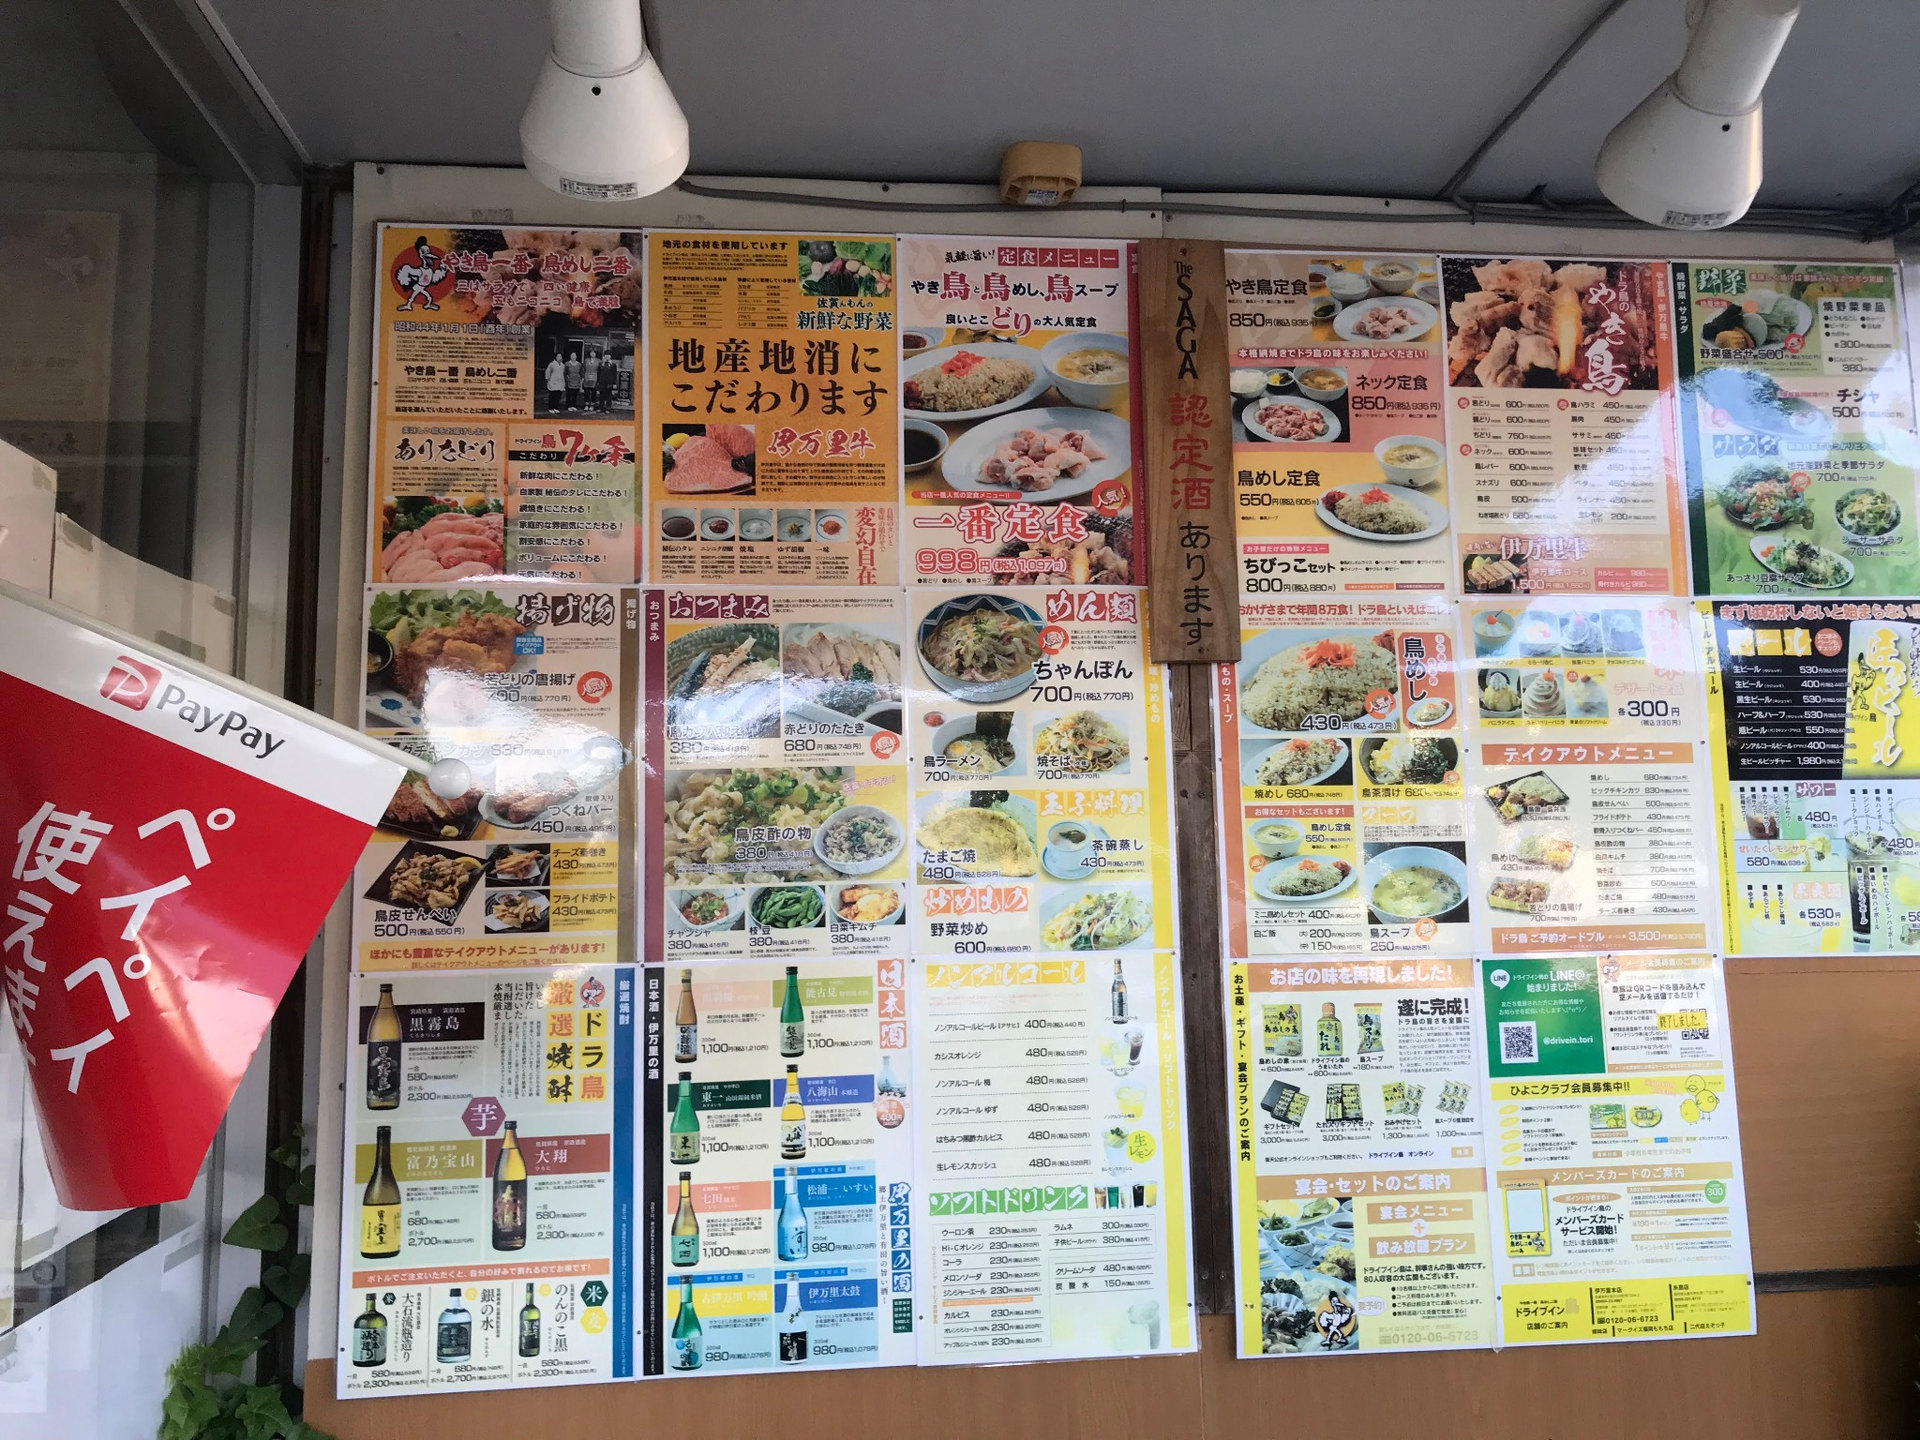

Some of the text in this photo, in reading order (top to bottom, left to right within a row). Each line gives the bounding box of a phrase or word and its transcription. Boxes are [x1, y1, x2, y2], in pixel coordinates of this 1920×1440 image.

[662, 240, 788, 250] 地元の食材を使用しています
[440, 250, 632, 276] やき鳥一番 鳥めし二番
[1000, 248, 1117, 266] 定食メニュー
[1175, 261, 1193, 275] The
[1226, 279, 1308, 296] やき鳥定食
[797, 311, 893, 331] 新鮮な野菜
[1175, 275, 1199, 380] SAGA
[668, 338, 882, 375] 地産地消に
[404, 366, 517, 379] やき鳥一番 鳥めし二番
[1356, 375, 1428, 390] ネック定食
[671, 379, 888, 416] こだわります
[767, 427, 876, 459] 伊万里牛
[1168, 392, 1215, 510] 認定酒
[1238, 470, 1321, 487] 鳥めし定食
[913, 502, 1090, 544] 一番定食
[855, 507, 877, 586] 変幻自在
[1244, 558, 1335, 574] ちびっこセット
[1180, 521, 1214, 647] あります
[515, 592, 616, 627] 揚げ物
[669, 592, 770, 620] おつまみ
[1047, 589, 1138, 623] めん類
[649, 601, 660, 641] おつまみ
[1033, 659, 1133, 681] ちゃんぽん
[1403, 637, 1428, 702] 鳥めし
[156, 682, 287, 761] PayPay
[784, 723, 865, 735] 赤どりのたたき
[924, 756, 981, 767] 鳥ラーメン
[1037, 755, 1071, 767] 焼そば
[1504, 748, 1673, 763] テイクアウトメニュー
[1254, 789, 1284, 799] 焼めし
[548, 805, 613, 817] つくねバー
[735, 827, 812, 842] 鳥皮酢の物
[1311, 823, 1351, 832] 鳥めし定食
[1092, 839, 1144, 851] 茶碗蒸し
[923, 849, 976, 864] たまご焼
[553, 893, 616, 904] フライドポテト
[375, 908, 457, 923] 鳥皮せんべい
[3, 801, 114, 1067] 使えま
[667, 928, 712, 938] チャンジャ
[749, 925, 771, 935] 枝豆
[830, 922, 877, 933] 白菜キムチ
[930, 922, 988, 937] 野菜炒め
[1254, 929, 1276, 938] 白ご飯
[1370, 928, 1410, 938] 鳥スープ
[50, 807, 237, 1095] ペイペイ
[1270, 968, 1453, 985] お店の味を再現しました!
[1397, 998, 1470, 1016] 遂に完成!
[648, 979, 659, 1080] 日本酒・伊万里の酒
[1543, 1035, 1594, 1045] @drivein.tori
[579, 1012, 607, 1101] ドラ鳥
[934, 1051, 981, 1060] カシスオレンジ
[806, 1084, 838, 1098] 八海山
[935, 1079, 981, 1088] ノンアルコール
[1510, 1082, 1630, 1096] ひよこクラブ会員募集中!!
[470, 1104, 498, 1131] 芋
[936, 1106, 983, 1115] ノンアルコール
[937, 1161, 997, 1171] 生レモンスカッシュ
[1552, 1167, 1685, 1182] メンバーズカードのご案内
[1295, 1174, 1451, 1196] 宴会・セットのご案内
[929, 1185, 1088, 1216] ソフトドリンク
[1380, 1206, 1464, 1220] 宴会メニュー
[1555, 1214, 1624, 1225] メンバーズカード
[941, 1228, 975, 1237] ウーロン茶
[1054, 1224, 1074, 1232] ラムネ
[943, 1273, 982, 1282] メロンソーダ
[587, 1286, 602, 1302] 米
[480, 1288, 494, 1330] 銀の水
[1516, 1307, 1565, 1317] ドライブイン
